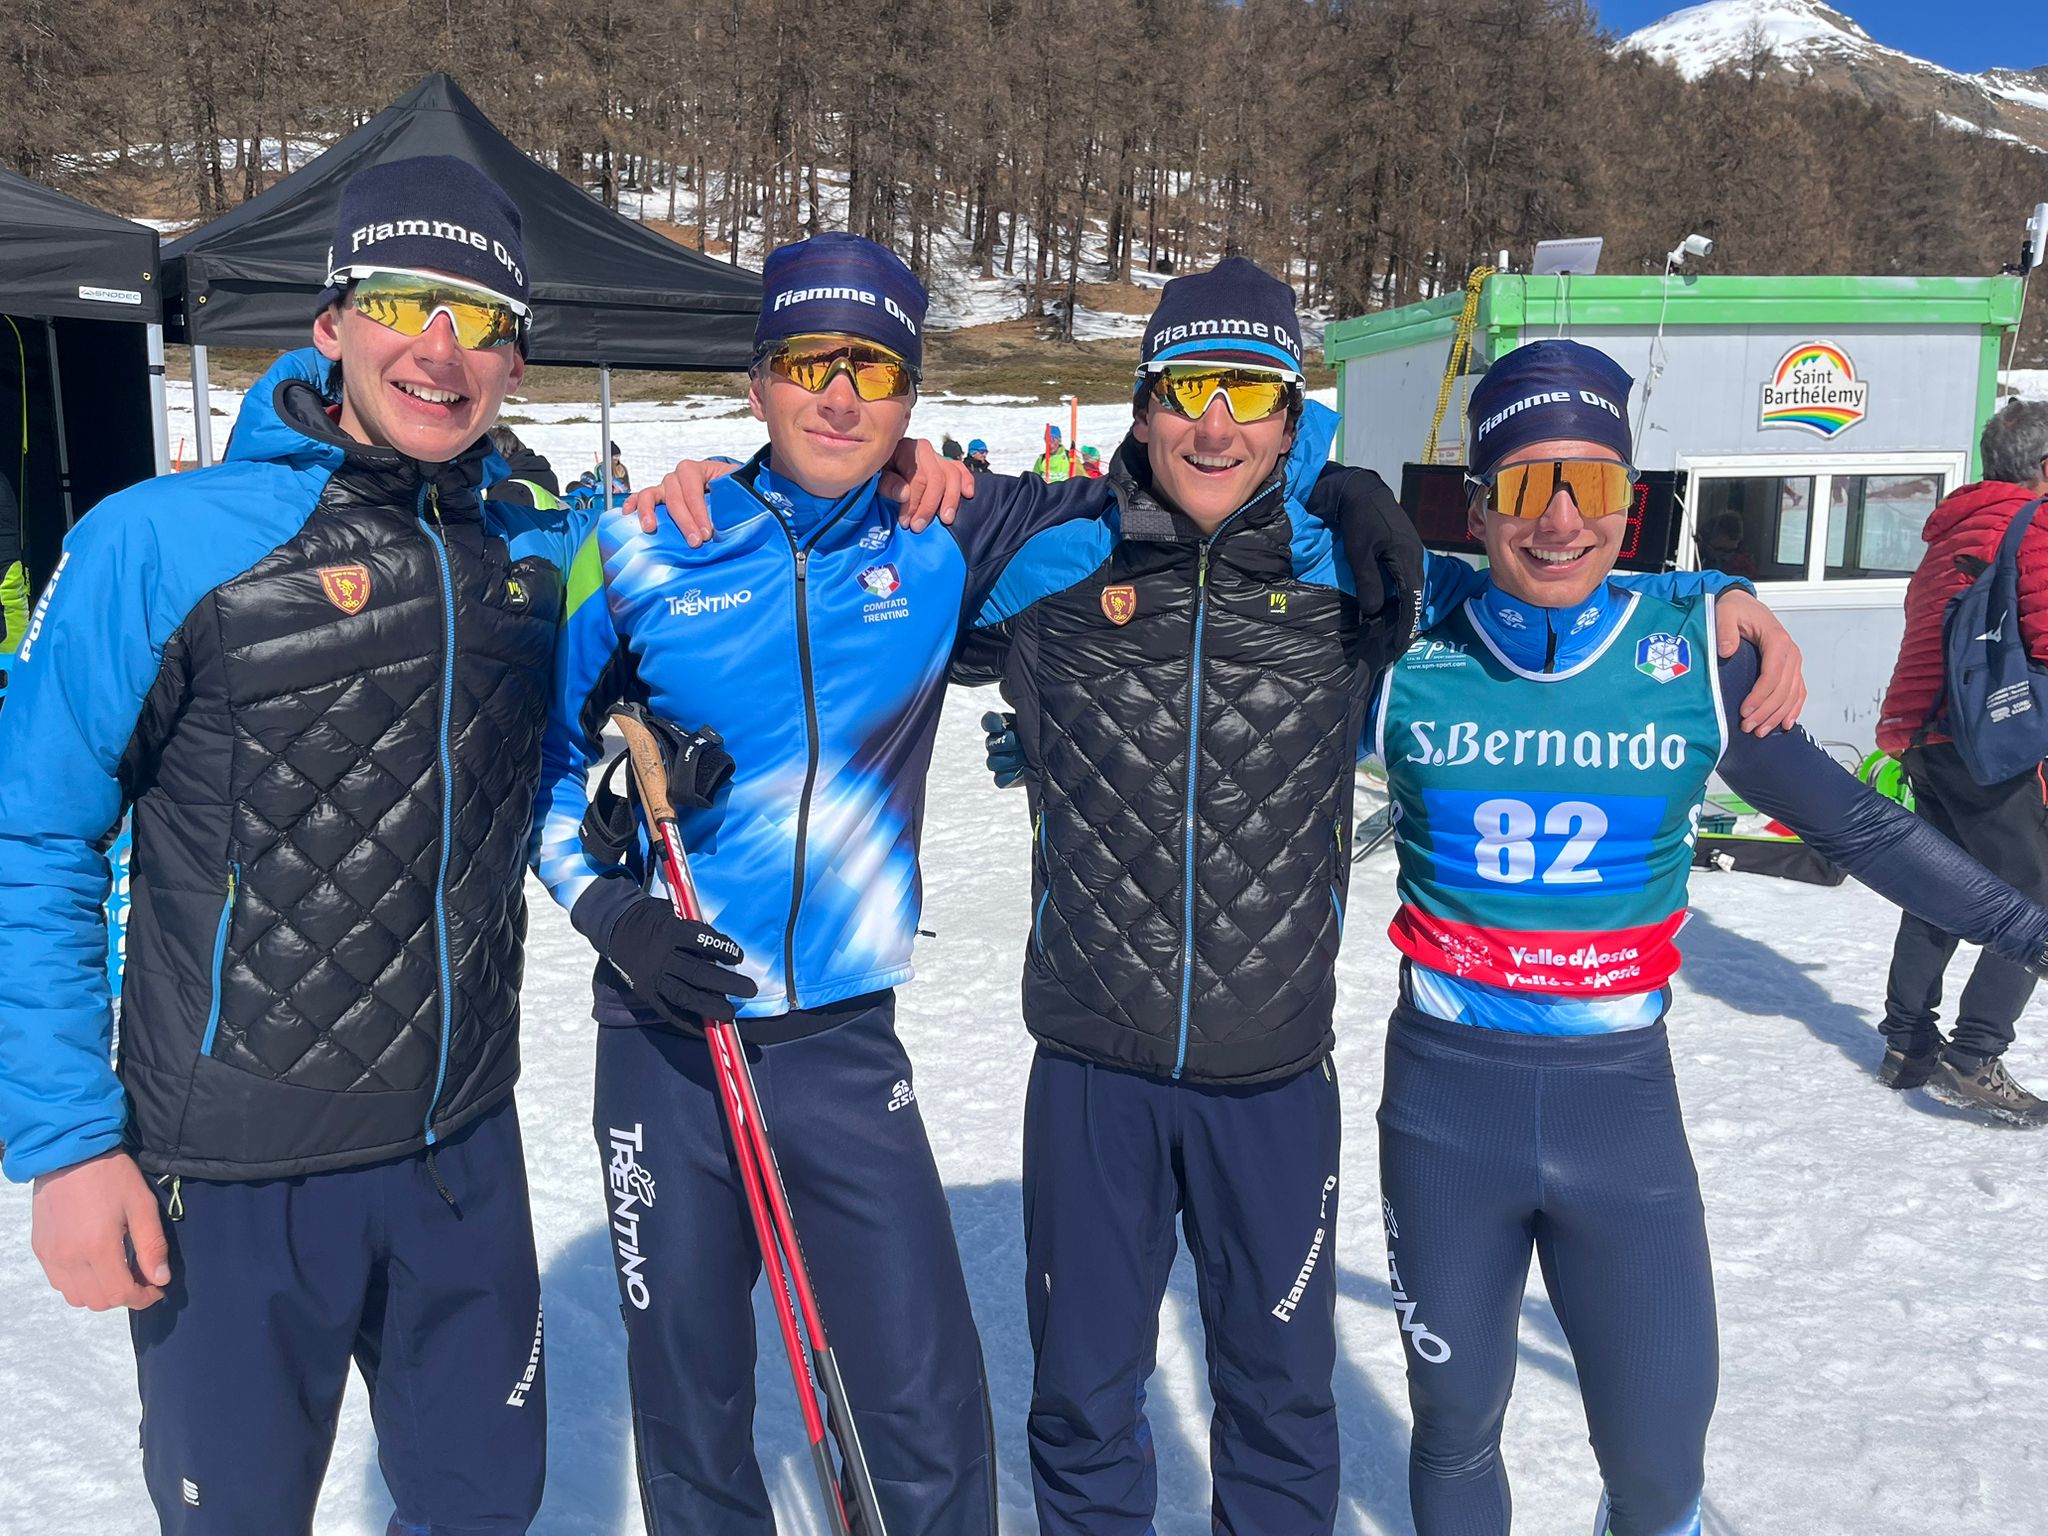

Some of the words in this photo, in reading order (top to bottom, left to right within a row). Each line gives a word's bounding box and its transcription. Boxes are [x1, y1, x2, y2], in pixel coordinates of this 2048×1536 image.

[352, 220, 488, 254] Fiamme
[493, 240, 523, 287] Oro
[773, 287, 876, 312] Fiamme
[884, 296, 916, 336] Oro
[1153, 318, 1269, 353] Fiamme
[1274, 325, 1300, 360] Oro
[1793, 368, 1832, 385] Saint
[1764, 385, 1864, 408] Barthélemy
[1478, 391, 1570, 442] Fiamme
[1579, 390, 1620, 419] Oro
[665, 589, 752, 616] TRENTINO
[863, 597, 908, 613] COMITATO
[863, 609, 909, 623] TRENTINO
[1649, 634, 1682, 646] FISI
[1473, 799, 1608, 884] 82
[697, 933, 740, 958] sportful
[1508, 946, 1566, 968] Valle
[1568, 943, 1638, 969] d'Aosta
[609, 1123, 650, 1310] TRENTINO
[1271, 1227, 1326, 1323] Fiamme
[506, 1294, 543, 1408] Fiamm
